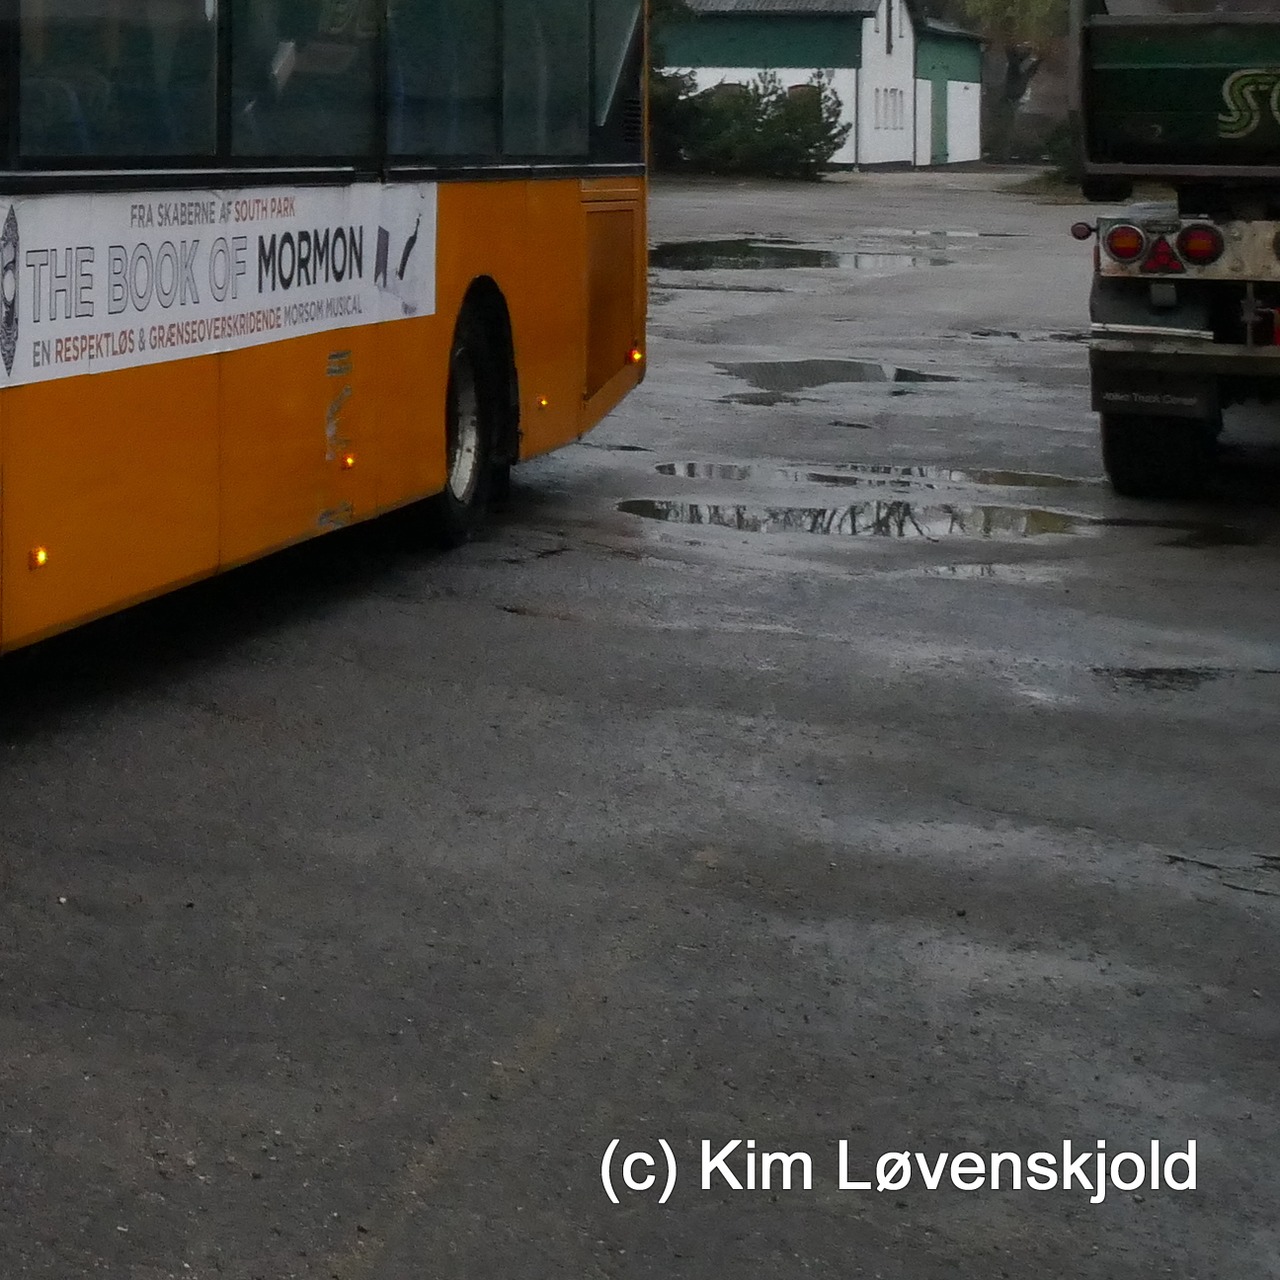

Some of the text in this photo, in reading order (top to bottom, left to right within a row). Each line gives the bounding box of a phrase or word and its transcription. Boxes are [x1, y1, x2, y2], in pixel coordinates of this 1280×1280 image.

[130, 195, 296, 228] FRA SKABERNE AF SOUTH PARK
[25, 225, 363, 324] THE BOOK OF MORMON
[32, 294, 362, 368] EN RESPEKTLØS & GRÆNSEOVERSKRIDENDE MORSOM MUSICAL
